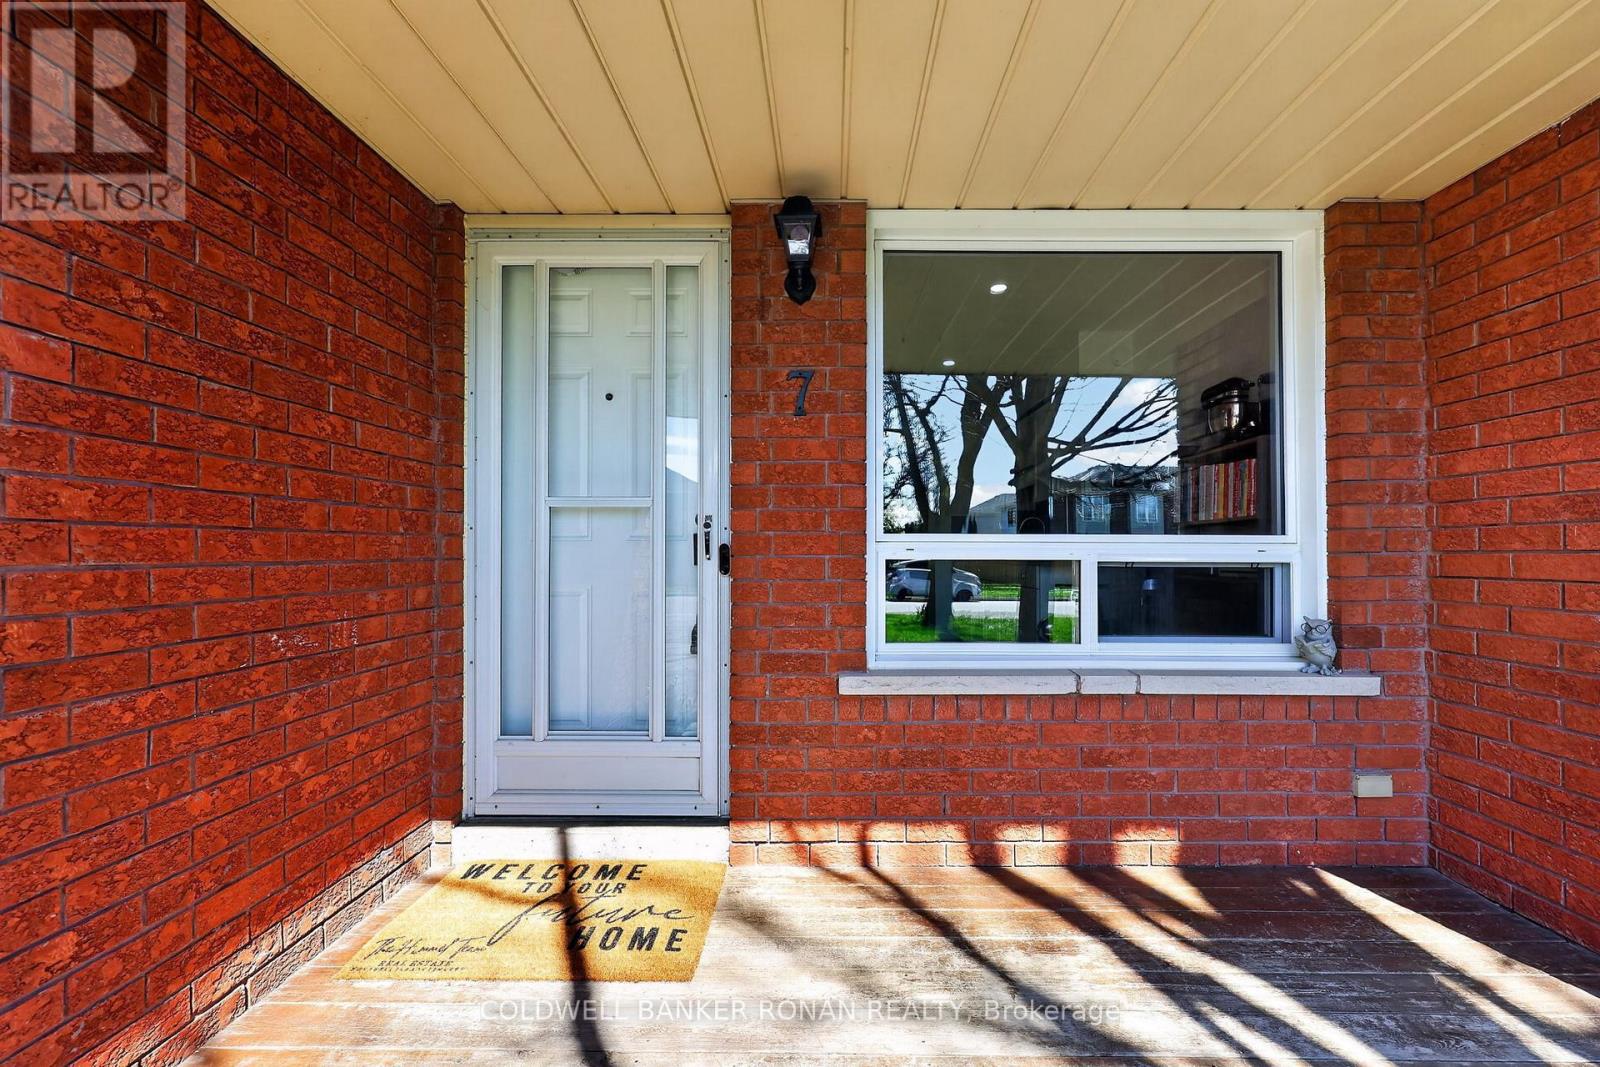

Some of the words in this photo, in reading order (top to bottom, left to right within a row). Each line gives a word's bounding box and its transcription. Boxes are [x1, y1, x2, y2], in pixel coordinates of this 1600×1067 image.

[786, 369, 816, 416] 7
[460, 863, 648, 881] WELCOME
[521, 882, 553, 894] TO
[560, 881, 627, 894] YOUR
[486, 888, 695, 946] future
[567, 925, 689, 952] HOME
